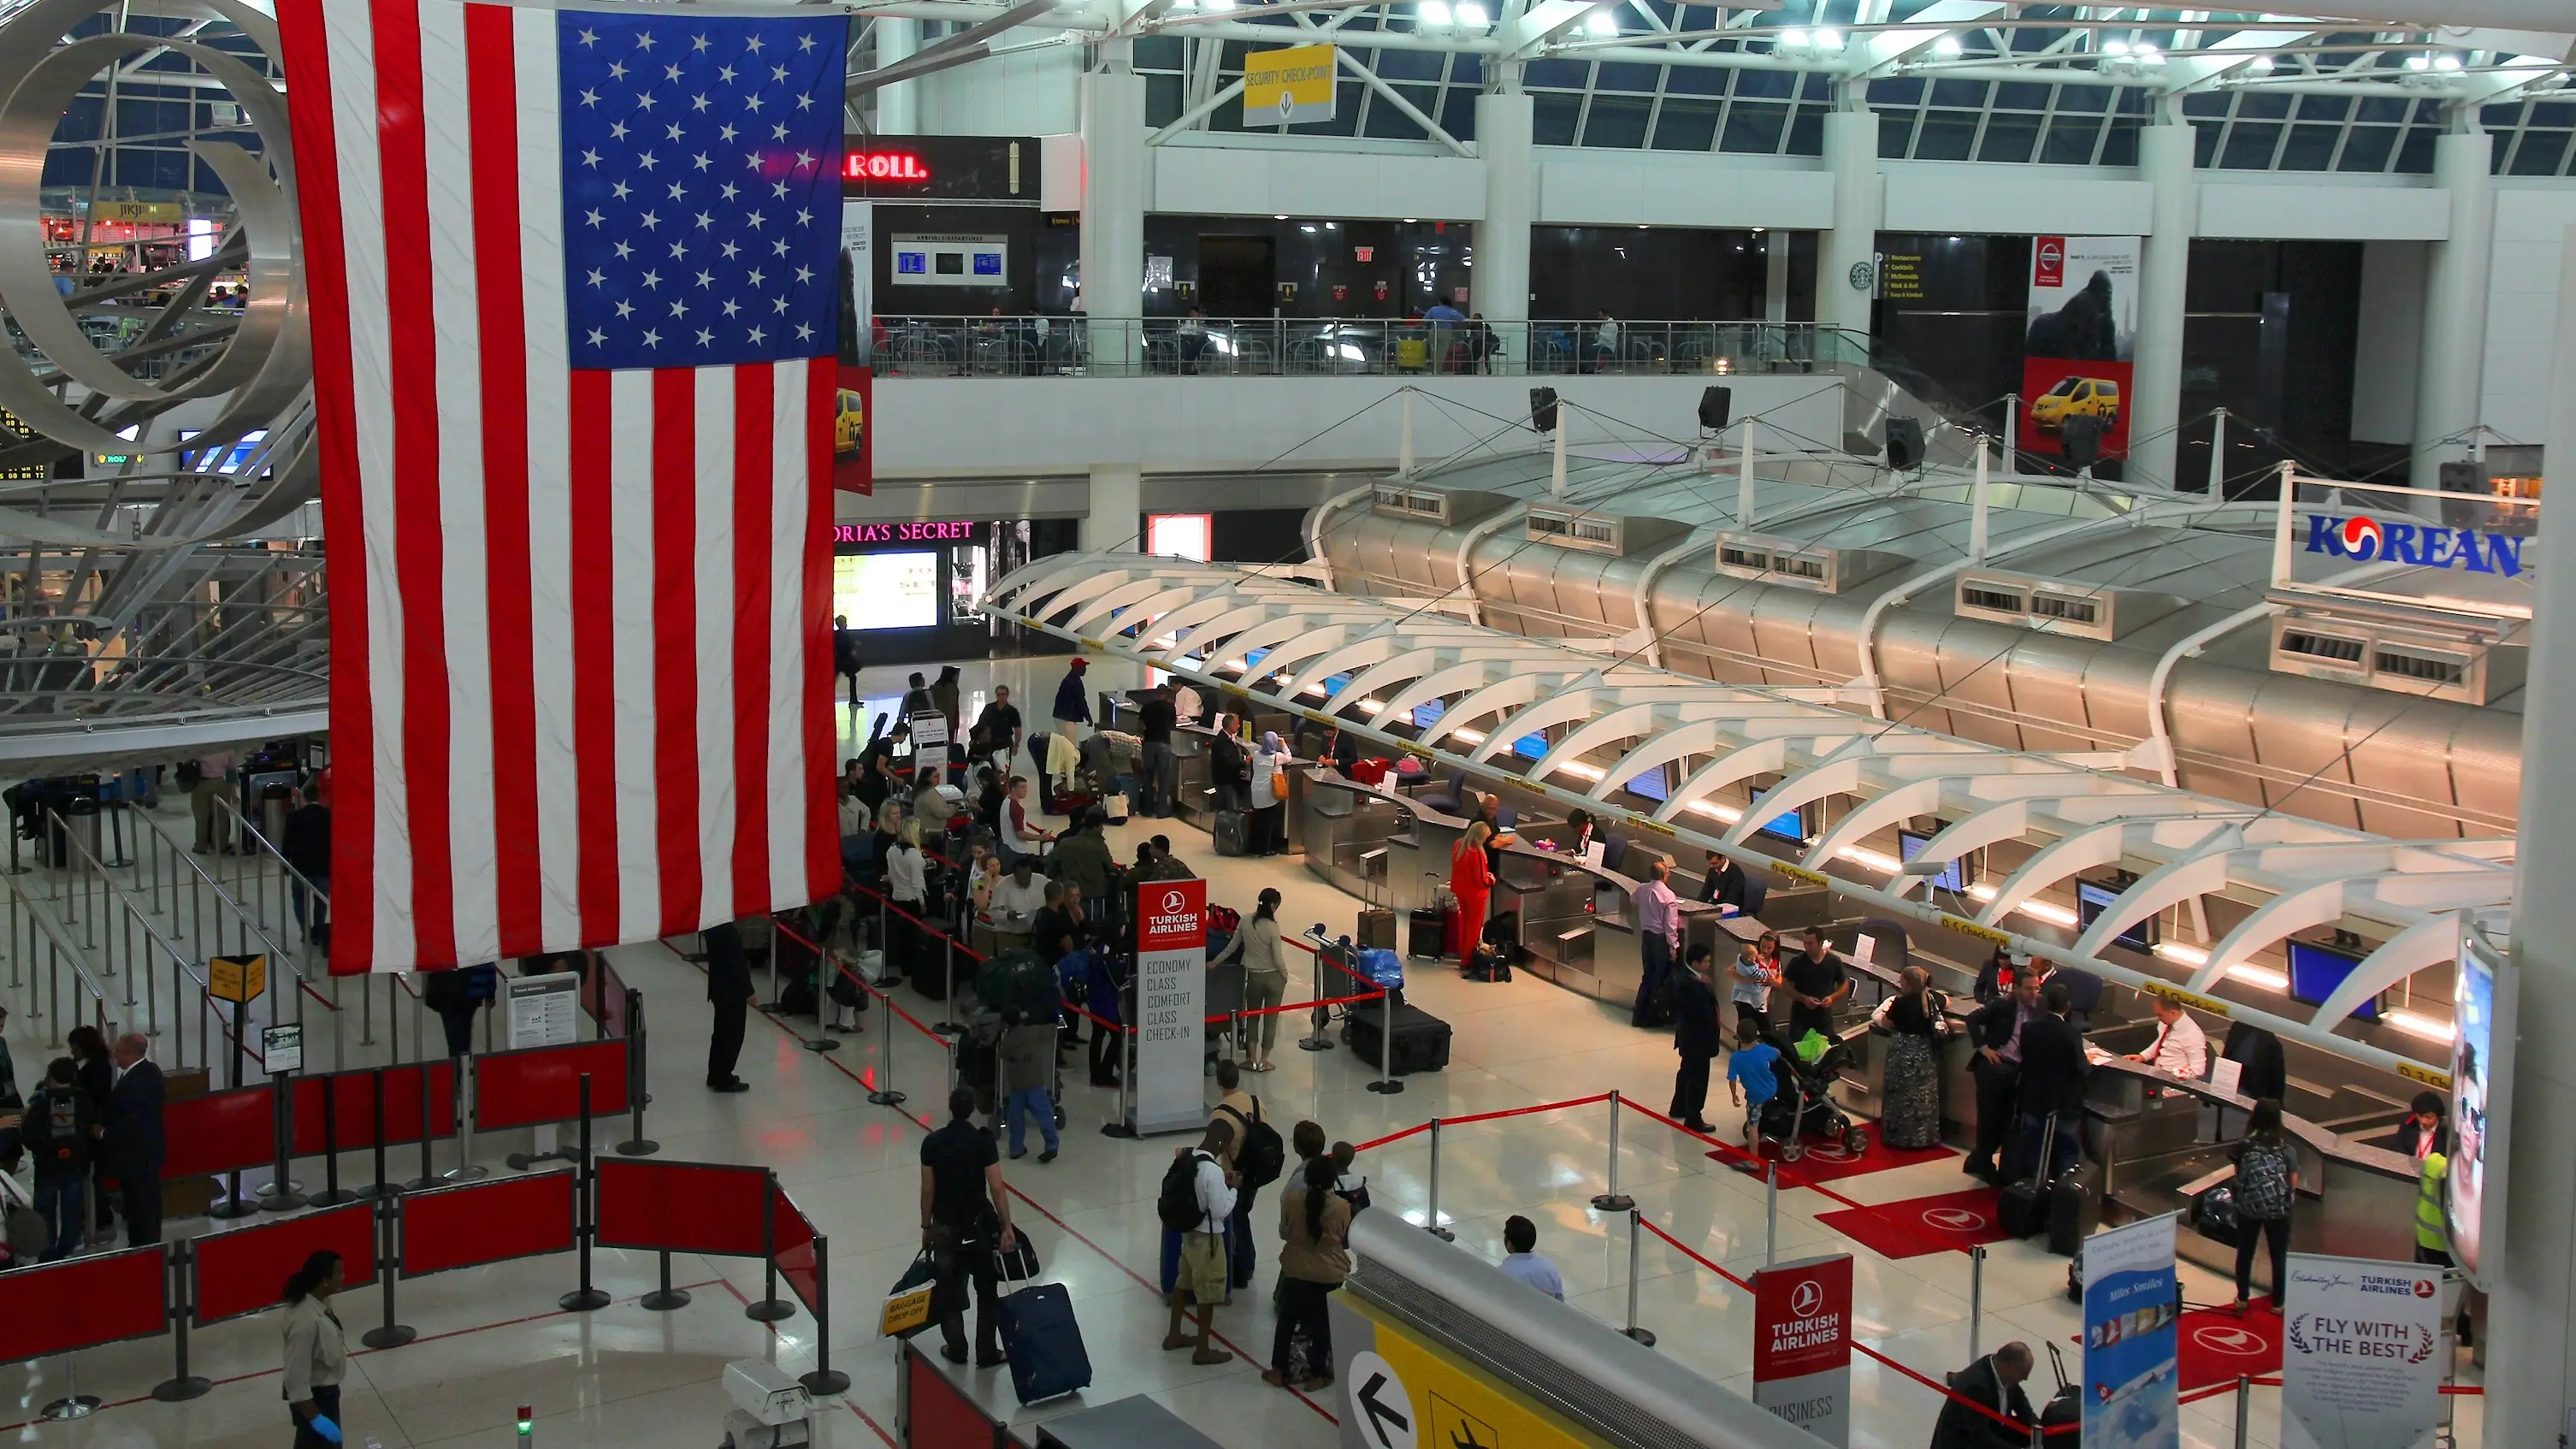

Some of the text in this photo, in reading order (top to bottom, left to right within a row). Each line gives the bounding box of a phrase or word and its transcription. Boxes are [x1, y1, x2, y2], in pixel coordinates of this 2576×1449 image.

[1246, 64, 1331, 86] SECURITY CHECK-POINT
[120, 204, 141, 217] JIKJI
[1357, 250, 1371, 261] EXIT
[899, 522, 973, 540] SECRET
[2306, 515, 2526, 577] KOREAN
[1788, 869, 1820, 886] Check-in
[1149, 913, 1197, 925] TURKISH
[1149, 923, 1197, 935] AIRLINES
[1953, 922, 1959, 931] 5
[1962, 926, 1998, 943] Check-in
[1147, 959, 1191, 974] ECONOMY
[1147, 977, 1176, 991] CLASS
[1148, 992, 1191, 1008] COMFORT
[2171, 992, 2213, 1012] Check-in
[1147, 1010, 1177, 1026] CLASS
[1146, 1026, 1190, 1042] CHECK-IN
[2360, 1275, 2412, 1286] TURKISH
[2360, 1286, 2412, 1296] AIRLINES
[889, 1296, 926, 1312] BAGGAGE
[888, 1306, 925, 1323] DROP-OFF
[1772, 1313, 1839, 1337] TURKISH
[2314, 1317, 2408, 1340] FLY WITH
[1771, 1328, 1839, 1352] AIRLINES
[2313, 1336, 2409, 1359] THE BEST
